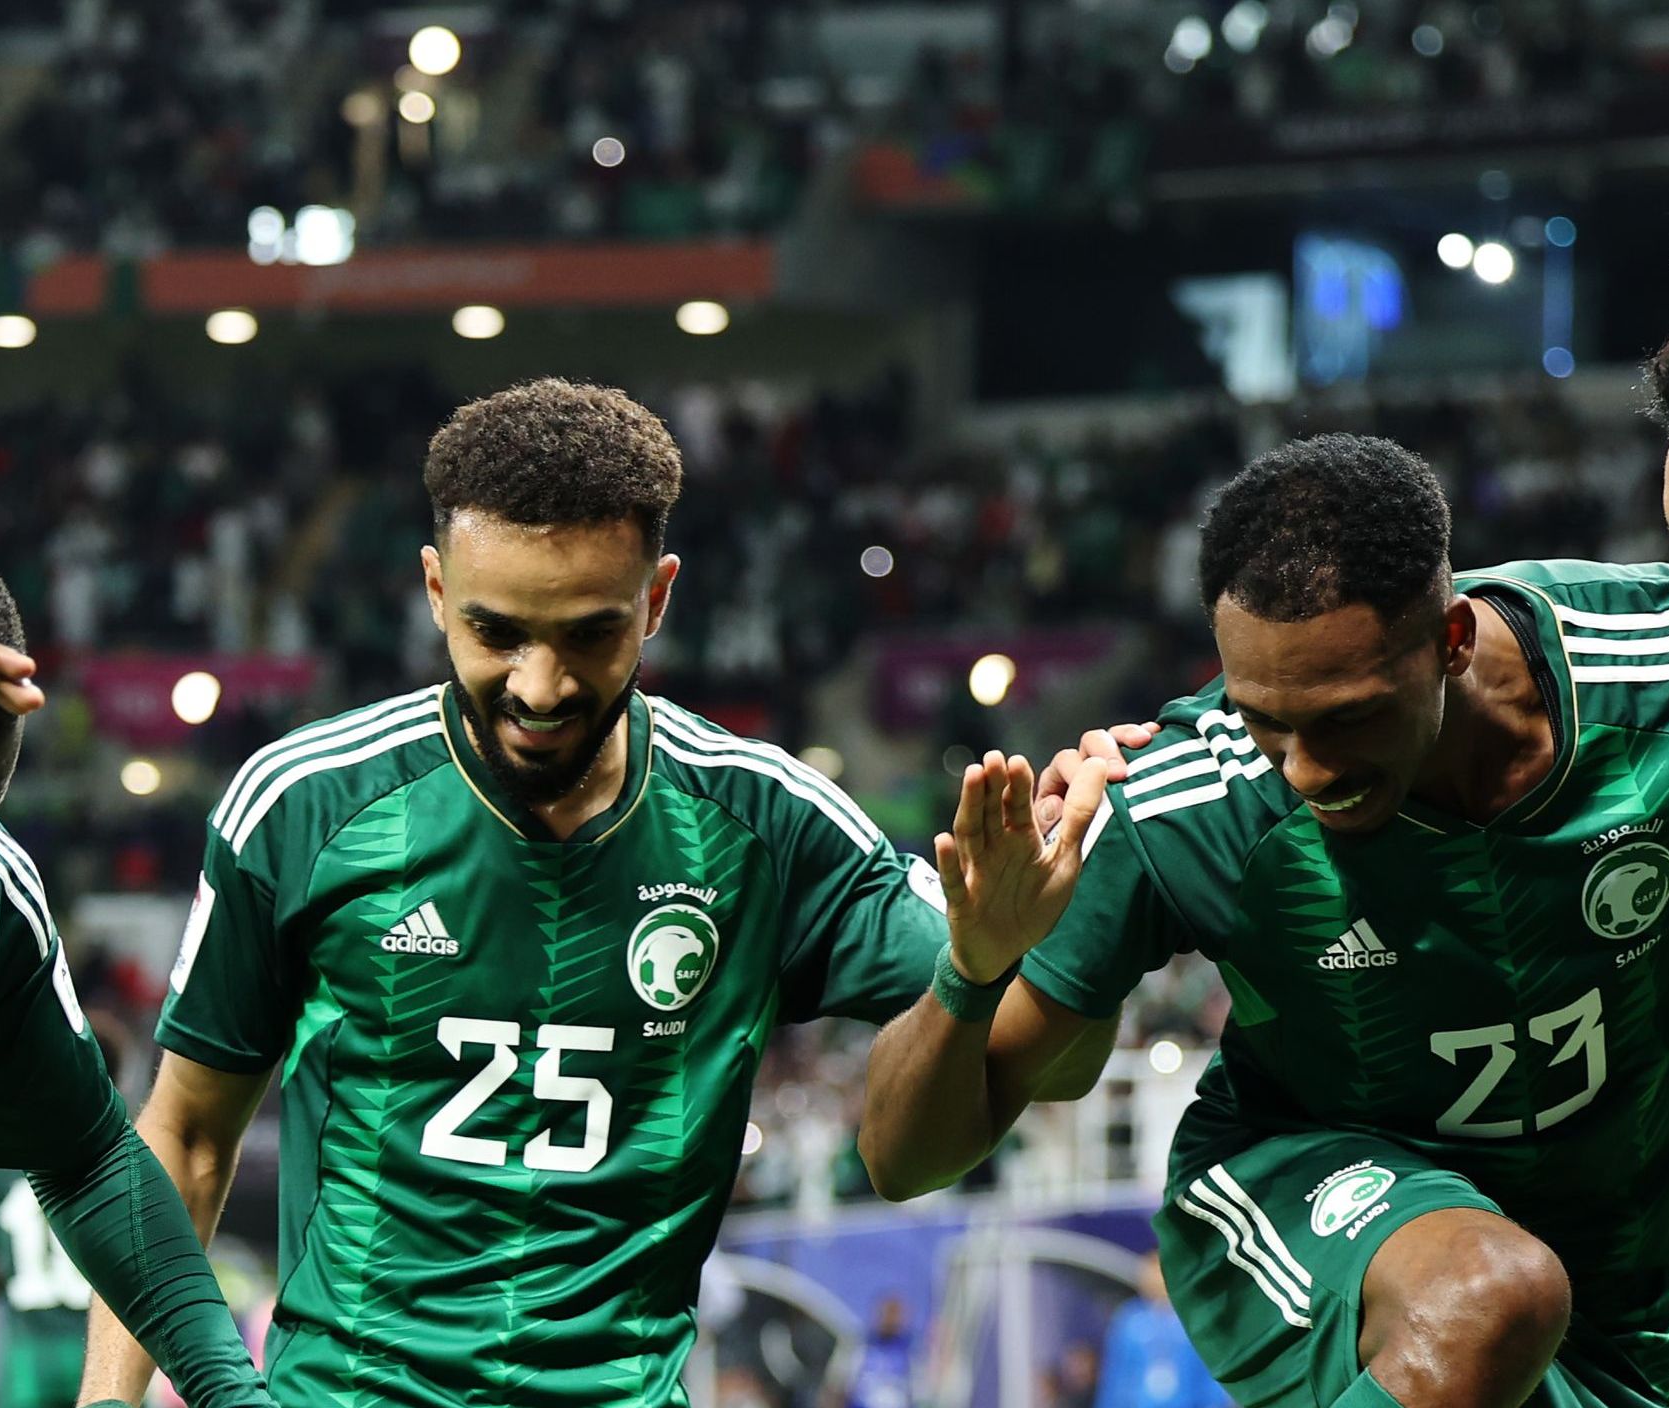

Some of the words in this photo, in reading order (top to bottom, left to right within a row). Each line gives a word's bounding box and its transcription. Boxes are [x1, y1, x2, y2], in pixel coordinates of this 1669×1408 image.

[637, 882, 718, 906] السعودية
[380, 933, 460, 956] adidas
[1317, 950, 1399, 970] adidas
[675, 969, 702, 981] SAFF
[642, 1019, 687, 1038] SAUDI
[1430, 987, 1607, 1139] 23
[419, 1016, 616, 1173] 25
